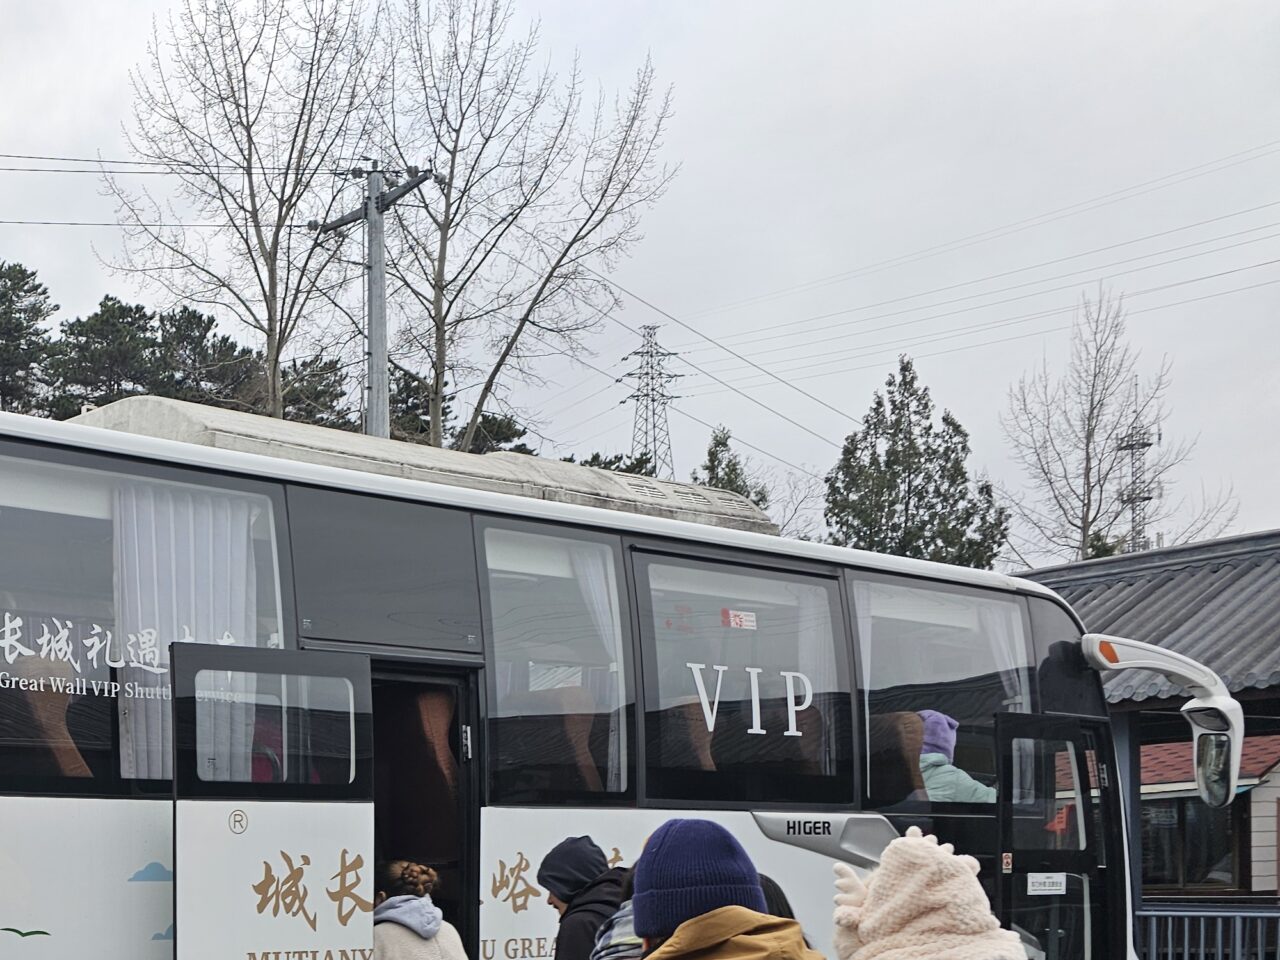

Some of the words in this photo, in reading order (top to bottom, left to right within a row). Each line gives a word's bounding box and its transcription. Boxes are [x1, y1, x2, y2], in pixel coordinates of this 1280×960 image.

[49, 676, 86, 696] Wall
[90, 680, 120, 698] VIP
[124, 682, 172, 700] Shuttl
[195, 687, 241, 704] ervice
[686, 662, 813, 736] VIP
[786, 820, 832, 836] HIGER
[504, 937, 557, 959] GRE
